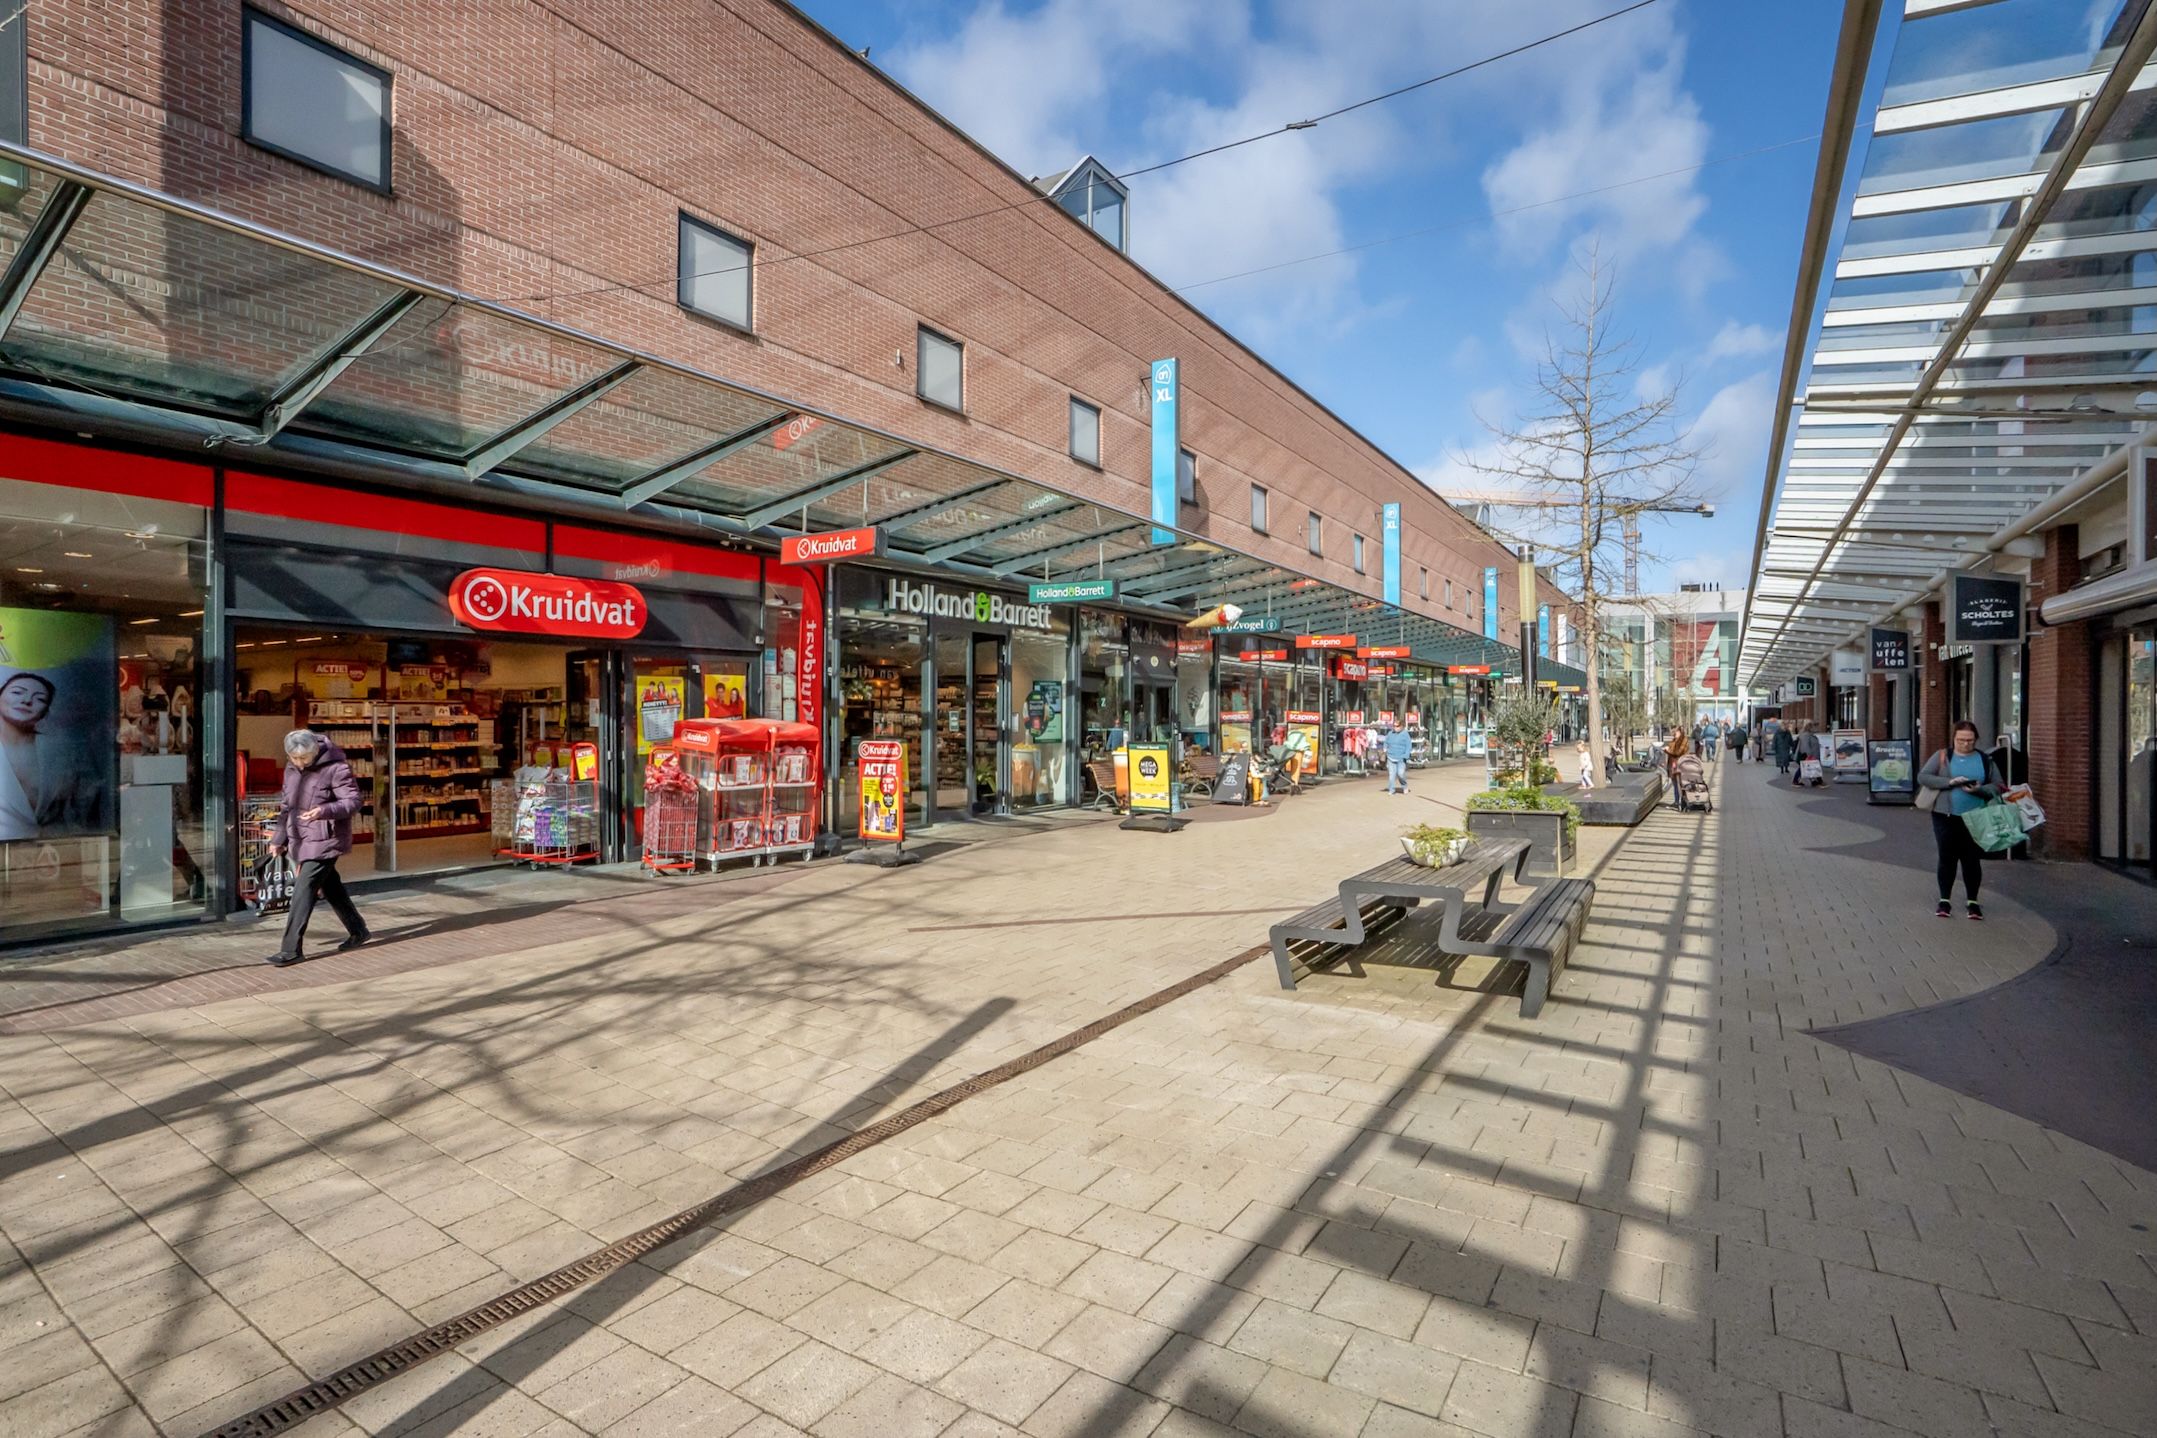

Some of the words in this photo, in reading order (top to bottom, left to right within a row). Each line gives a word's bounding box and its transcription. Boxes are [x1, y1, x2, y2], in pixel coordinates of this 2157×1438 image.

[1156, 388, 1173, 403] XL
[1386, 520, 1397, 529] XL
[811, 536, 857, 555] Kruidvat
[511, 585, 636, 627] Kruidvat
[1961, 610, 2014, 619] SCHOLTES
[1311, 638, 1341, 647] scapino
[1885, 658, 1905, 666] len
[316, 664, 348, 673] ACTIE!
[1343, 662, 1366, 680] scapino
[1289, 713, 1319, 721] scapino
[869, 745, 899, 756] Kruidvat
[864, 763, 897, 776] ACTIE!
[263, 869, 293, 881] van
